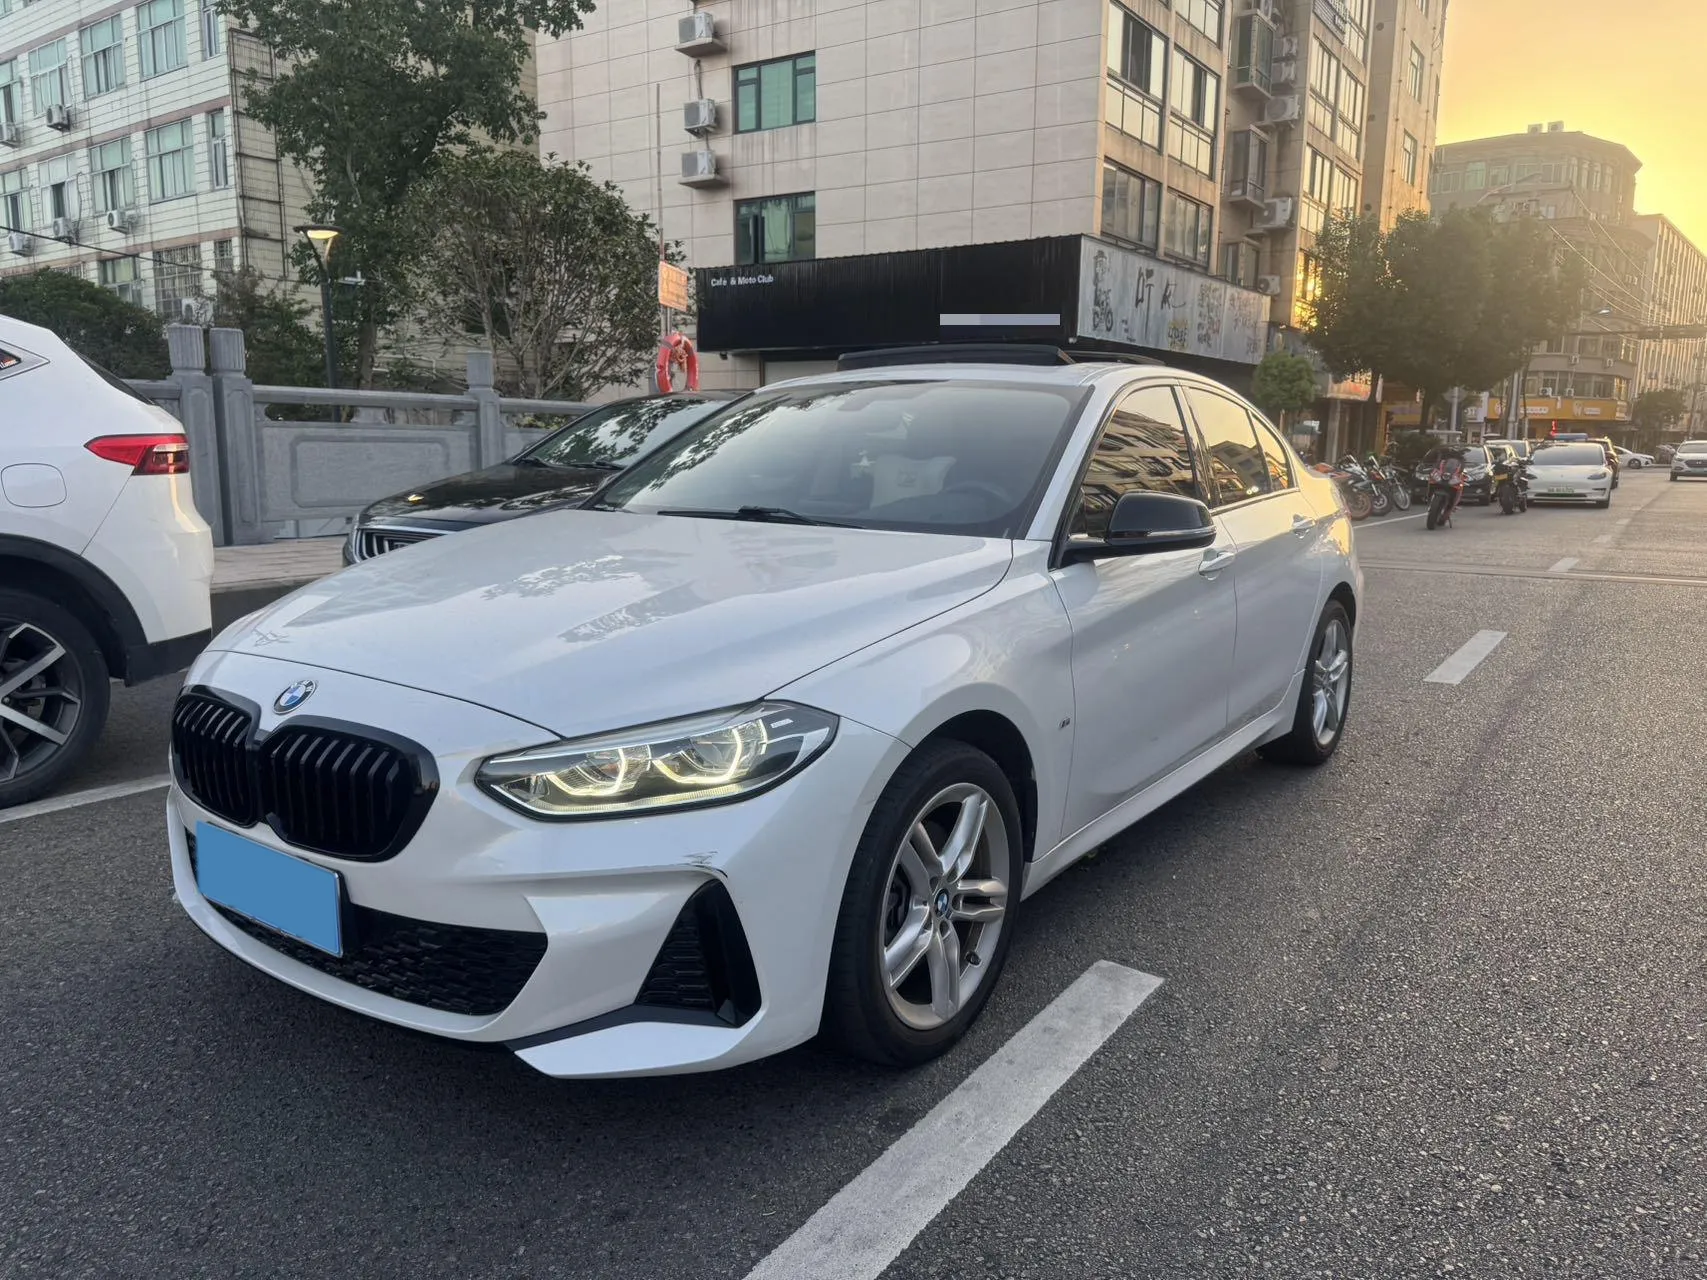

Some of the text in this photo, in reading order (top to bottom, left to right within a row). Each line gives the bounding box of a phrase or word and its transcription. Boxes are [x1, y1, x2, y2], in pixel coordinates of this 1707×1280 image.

[730, 277, 737, 286] &
[737, 276, 757, 286] Moto
[757, 274, 774, 284] Club
